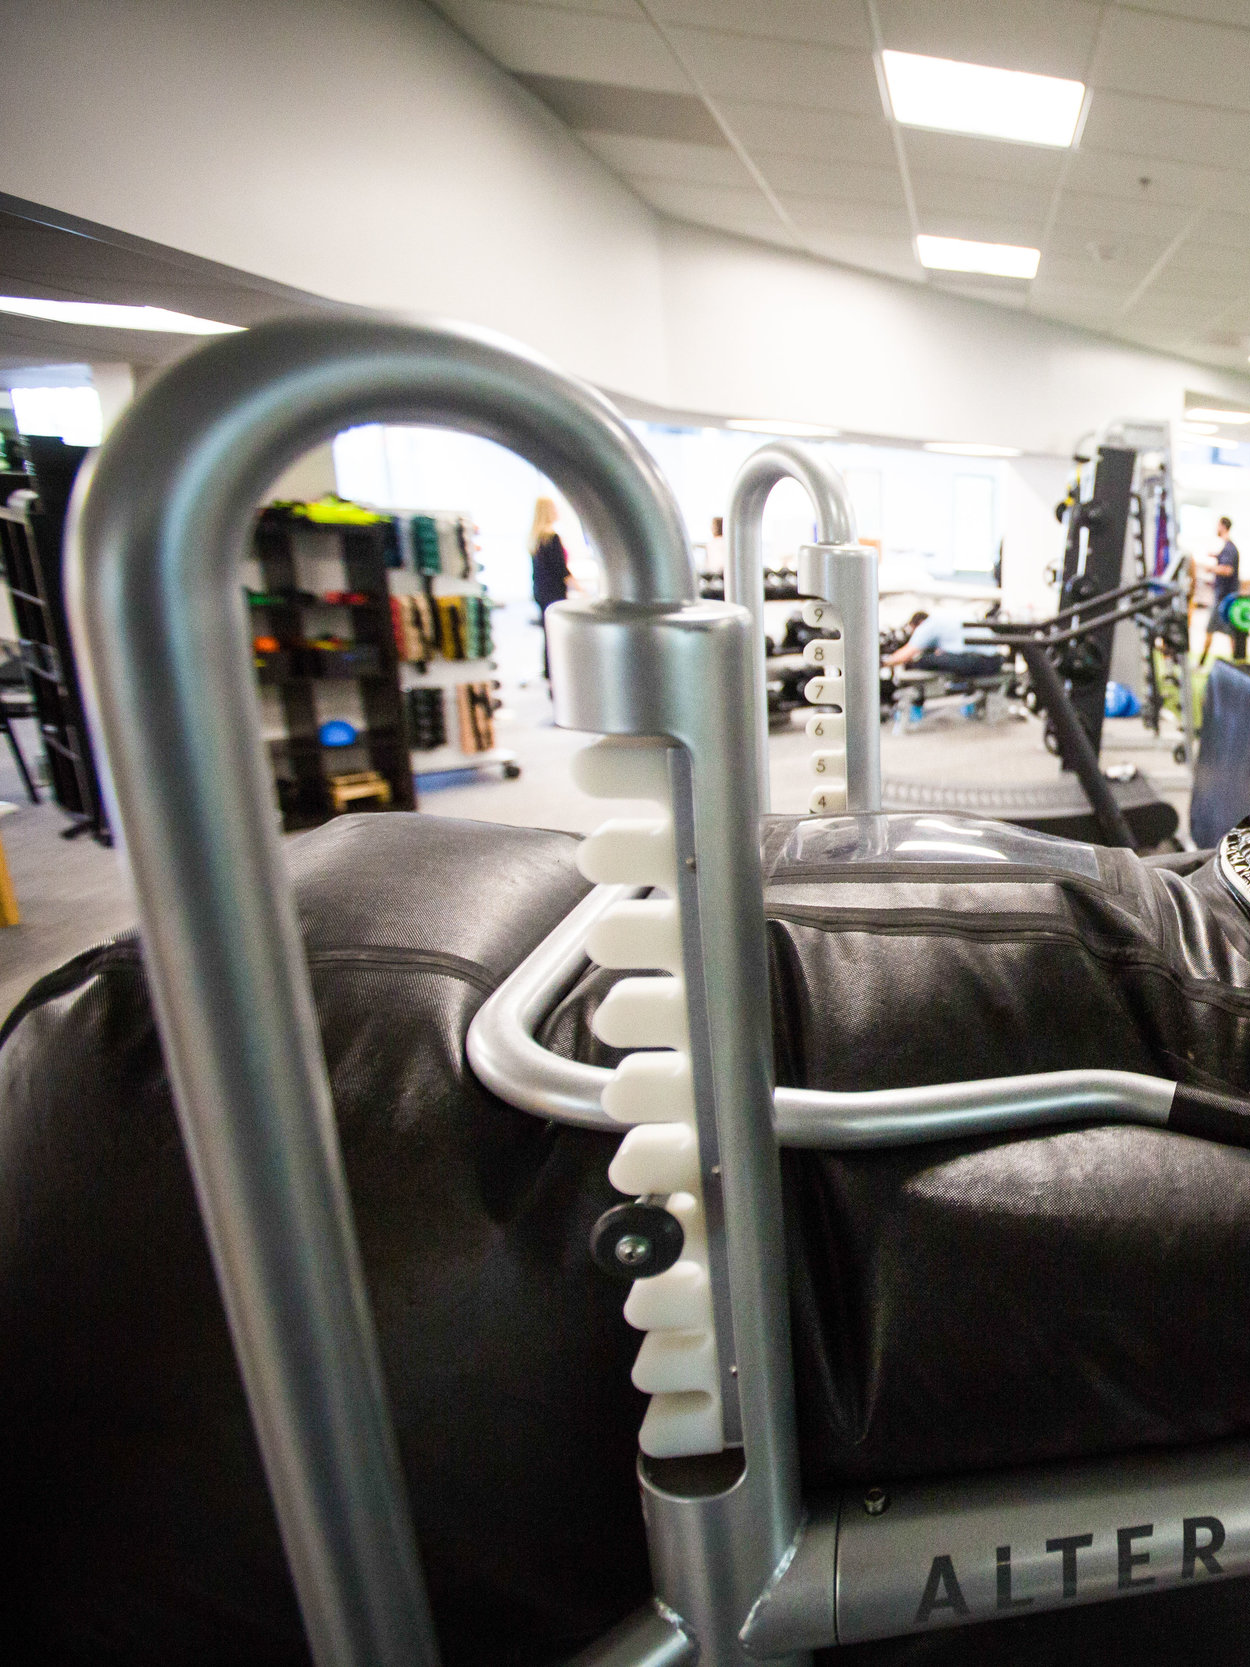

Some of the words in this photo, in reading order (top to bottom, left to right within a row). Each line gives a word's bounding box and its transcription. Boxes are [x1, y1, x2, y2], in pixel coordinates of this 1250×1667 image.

[814, 608, 824, 623] 9
[814, 646, 824, 661] 8
[815, 685, 824, 699] 7
[814, 721, 824, 737] 6
[816, 758, 826, 774] 5
[817, 795, 827, 809] 4
[914, 1515, 1226, 1624] ALTER
